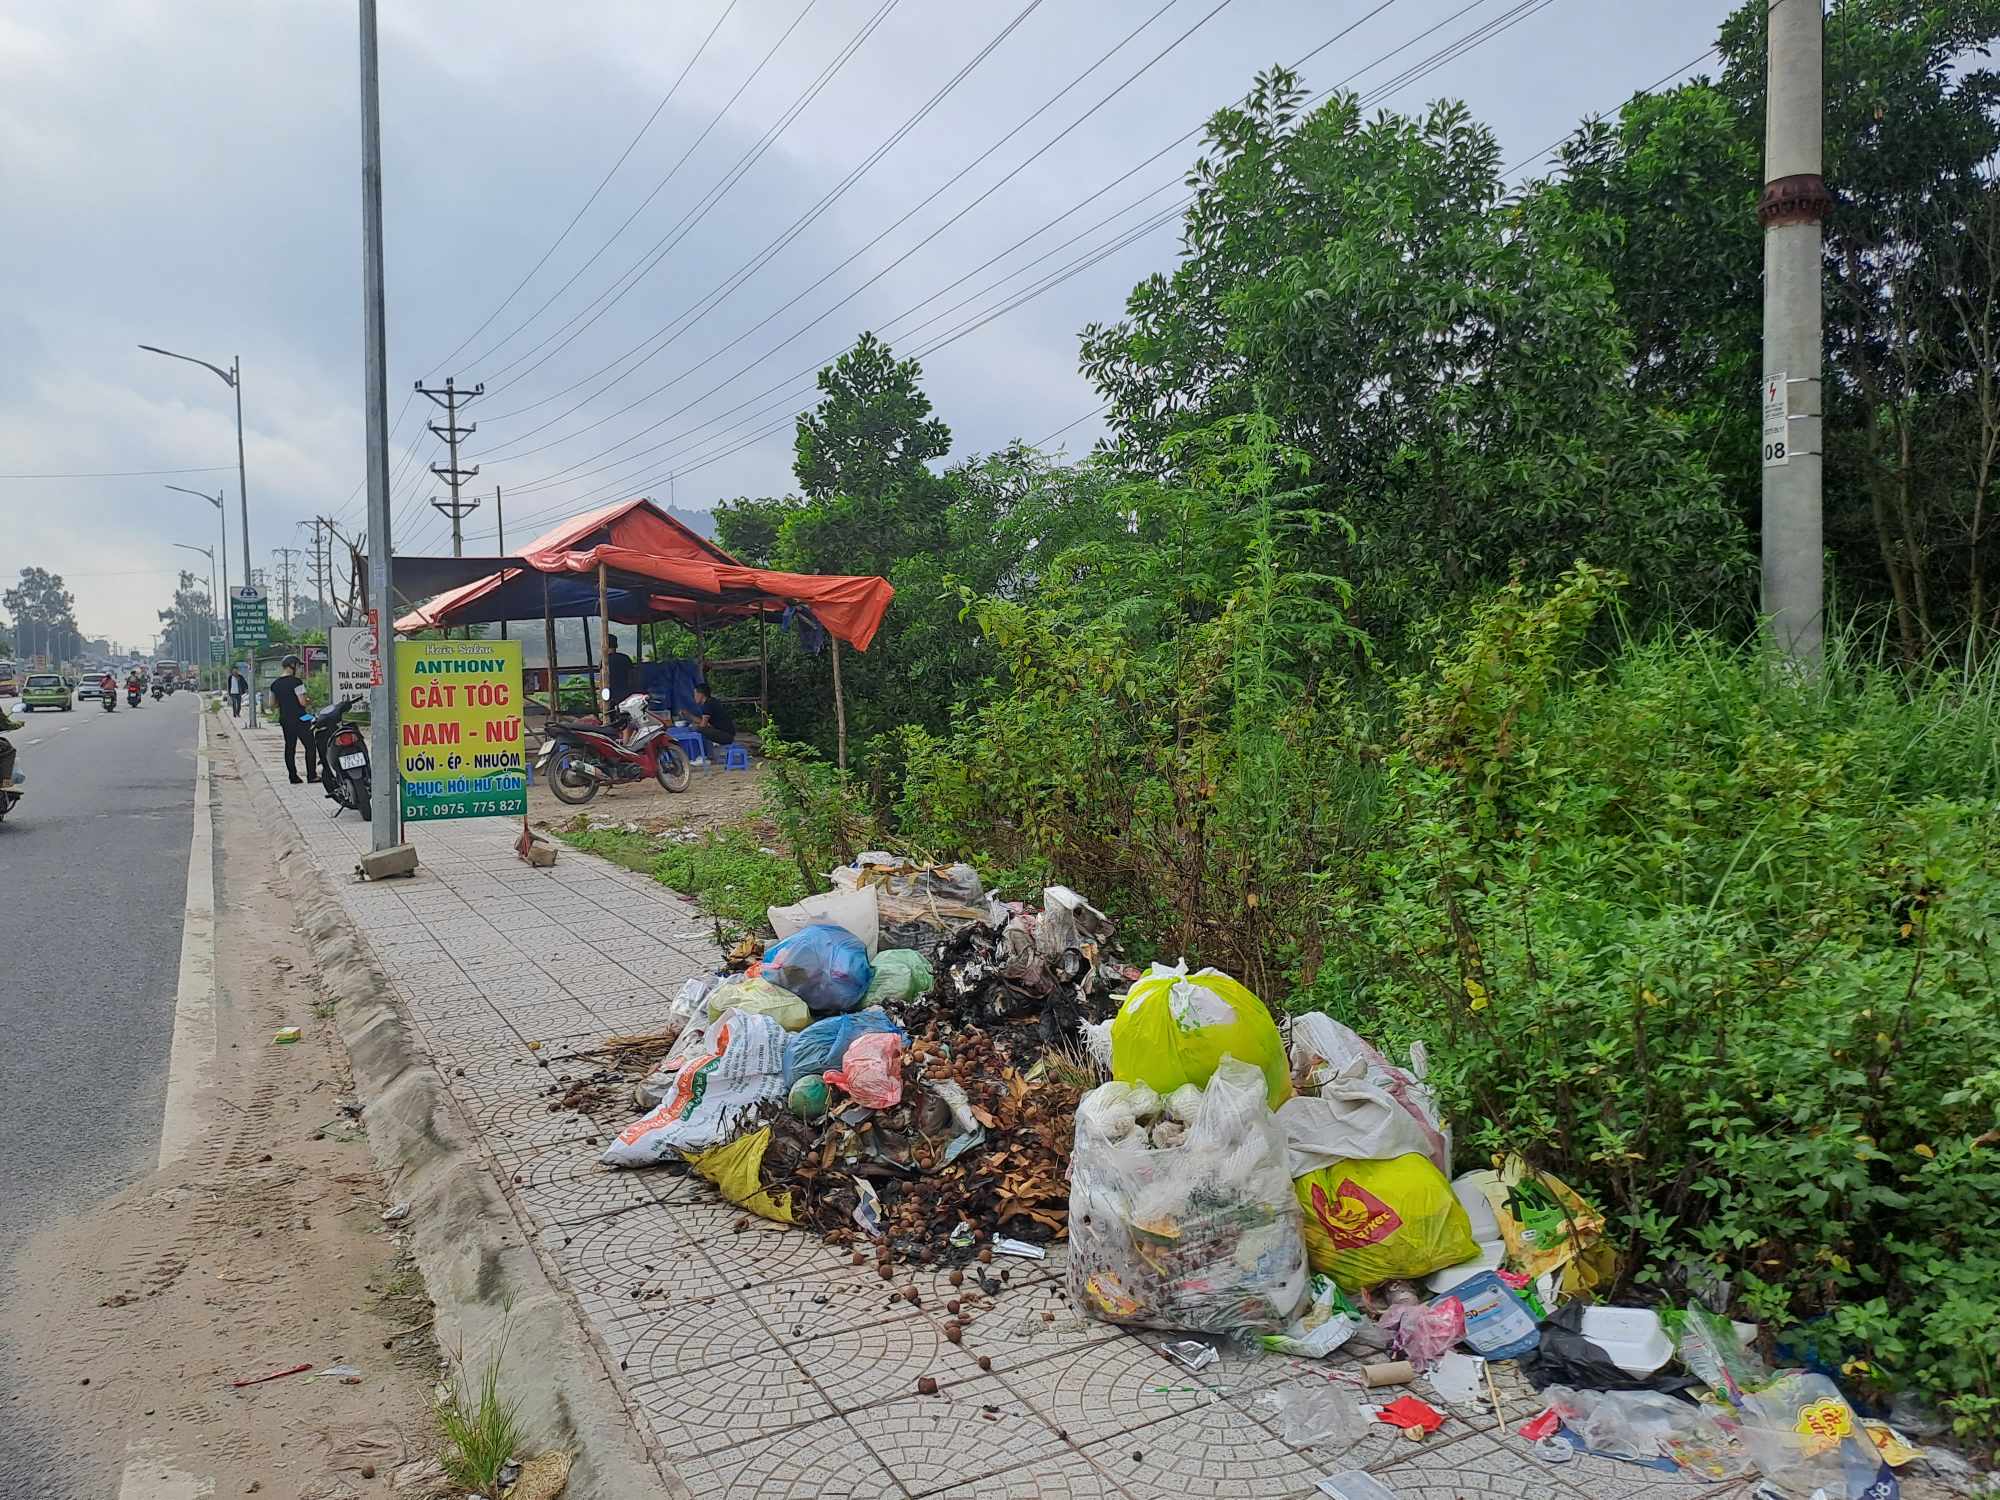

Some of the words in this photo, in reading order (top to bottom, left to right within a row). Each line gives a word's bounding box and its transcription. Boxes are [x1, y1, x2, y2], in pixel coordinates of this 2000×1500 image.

[1764, 442, 1785, 460] 08
[414, 659, 505, 674] ANTHONY
[410, 678, 457, 709] CẮT
[464, 680, 510, 707] TÓC
[403, 722, 460, 746] NAM
[485, 714, 521, 743] NỮ
[406, 751, 434, 772] UỐN
[448, 752, 462, 769] ÉP
[474, 749, 520, 772] NHUỘM
[407, 781, 443, 798] PHỤC
[406, 806, 428, 817] ĐT:
[433, 803, 468, 815] 0975.
[472, 801, 496, 813] 775
[500, 800, 522, 811] 827
